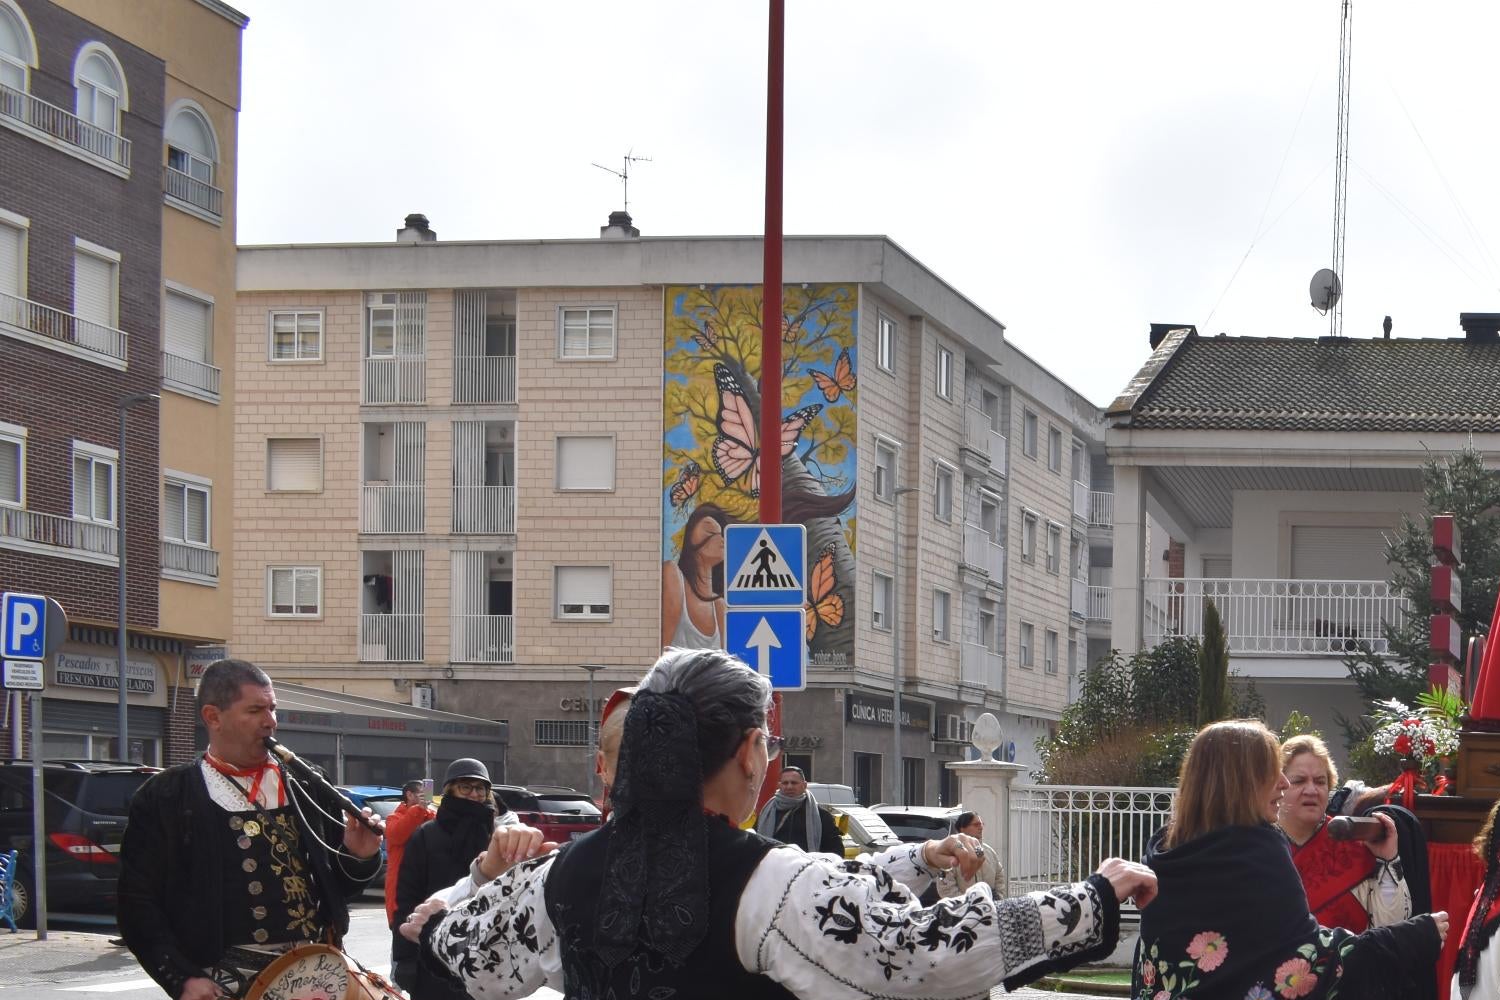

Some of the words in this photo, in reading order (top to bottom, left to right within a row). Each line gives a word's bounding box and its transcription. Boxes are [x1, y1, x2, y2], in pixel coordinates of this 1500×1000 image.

[12, 602, 38, 650] P
[57, 655, 100, 672] Pescados
[60, 672, 95, 686] FRESCOS
[95, 675, 102, 686] Y
[852, 700, 876, 720] CLÍNICA
